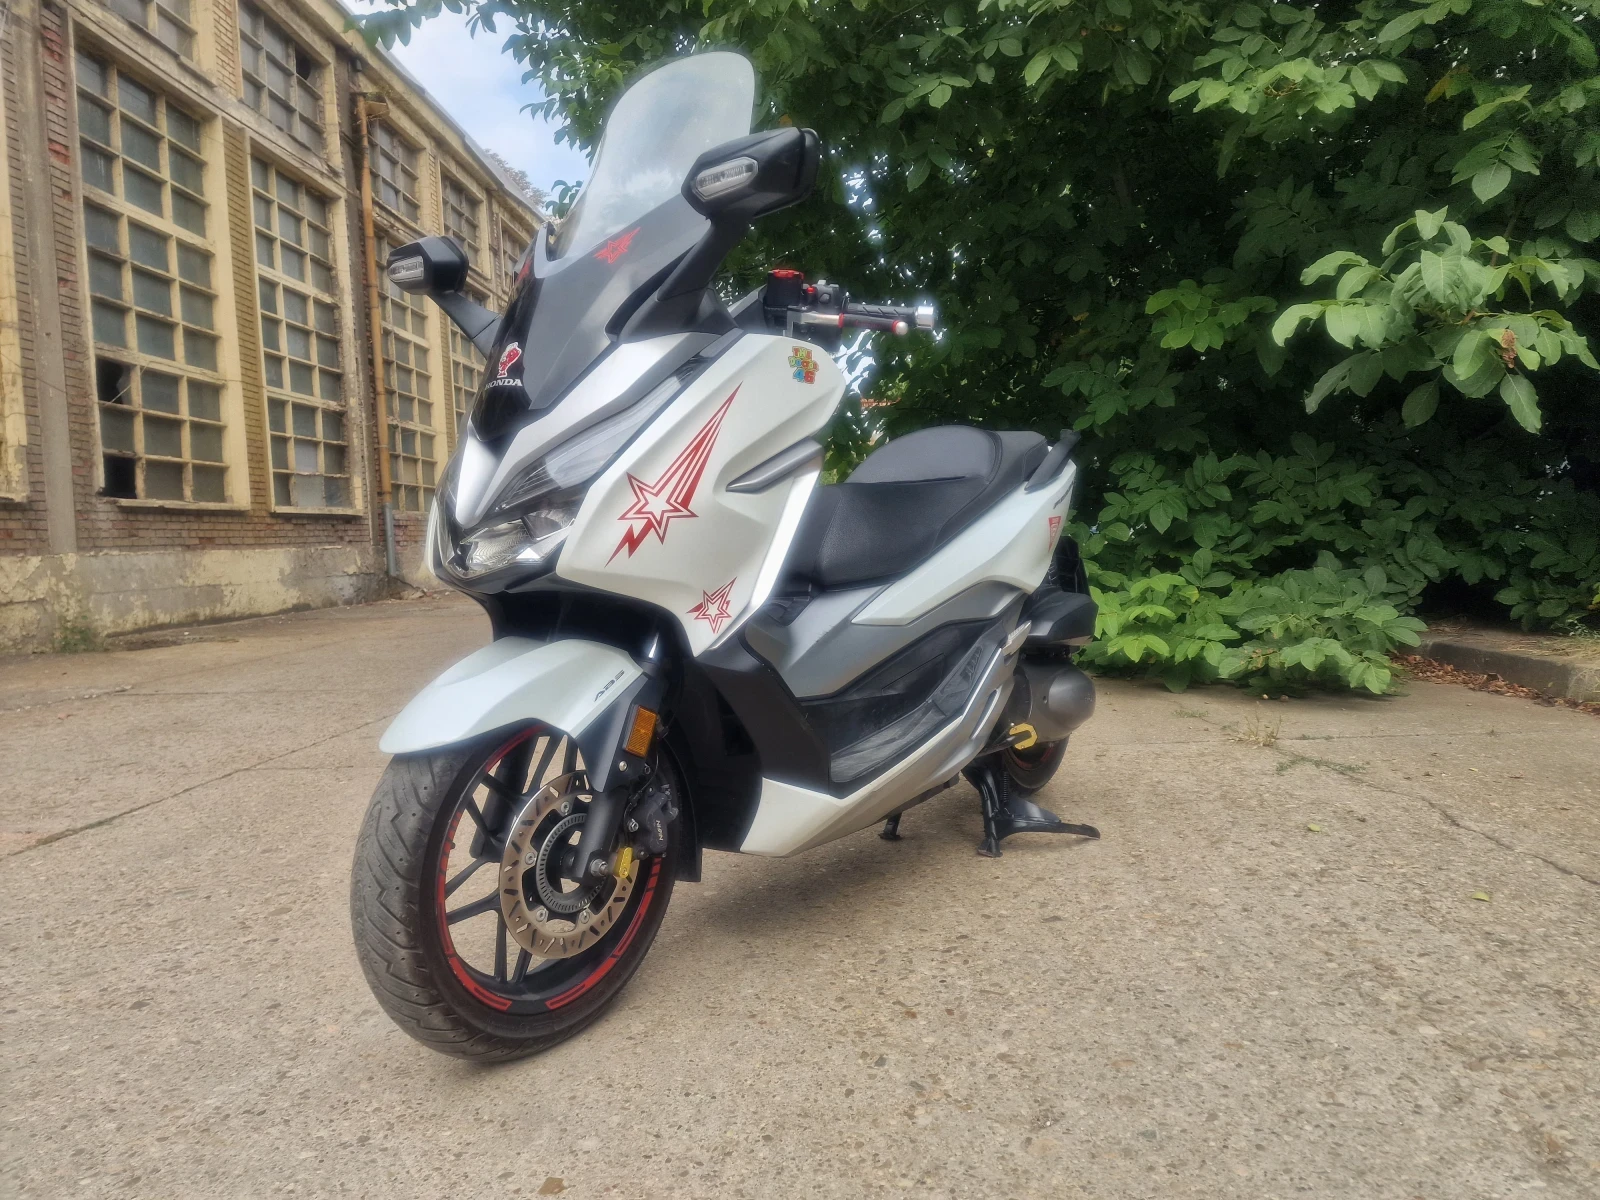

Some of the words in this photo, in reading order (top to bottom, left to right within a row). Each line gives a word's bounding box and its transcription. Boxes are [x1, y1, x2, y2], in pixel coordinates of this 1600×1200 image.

[484, 378, 523, 390] HONDA
[792, 367, 816, 385] 46
[594, 669, 625, 703] ABS
